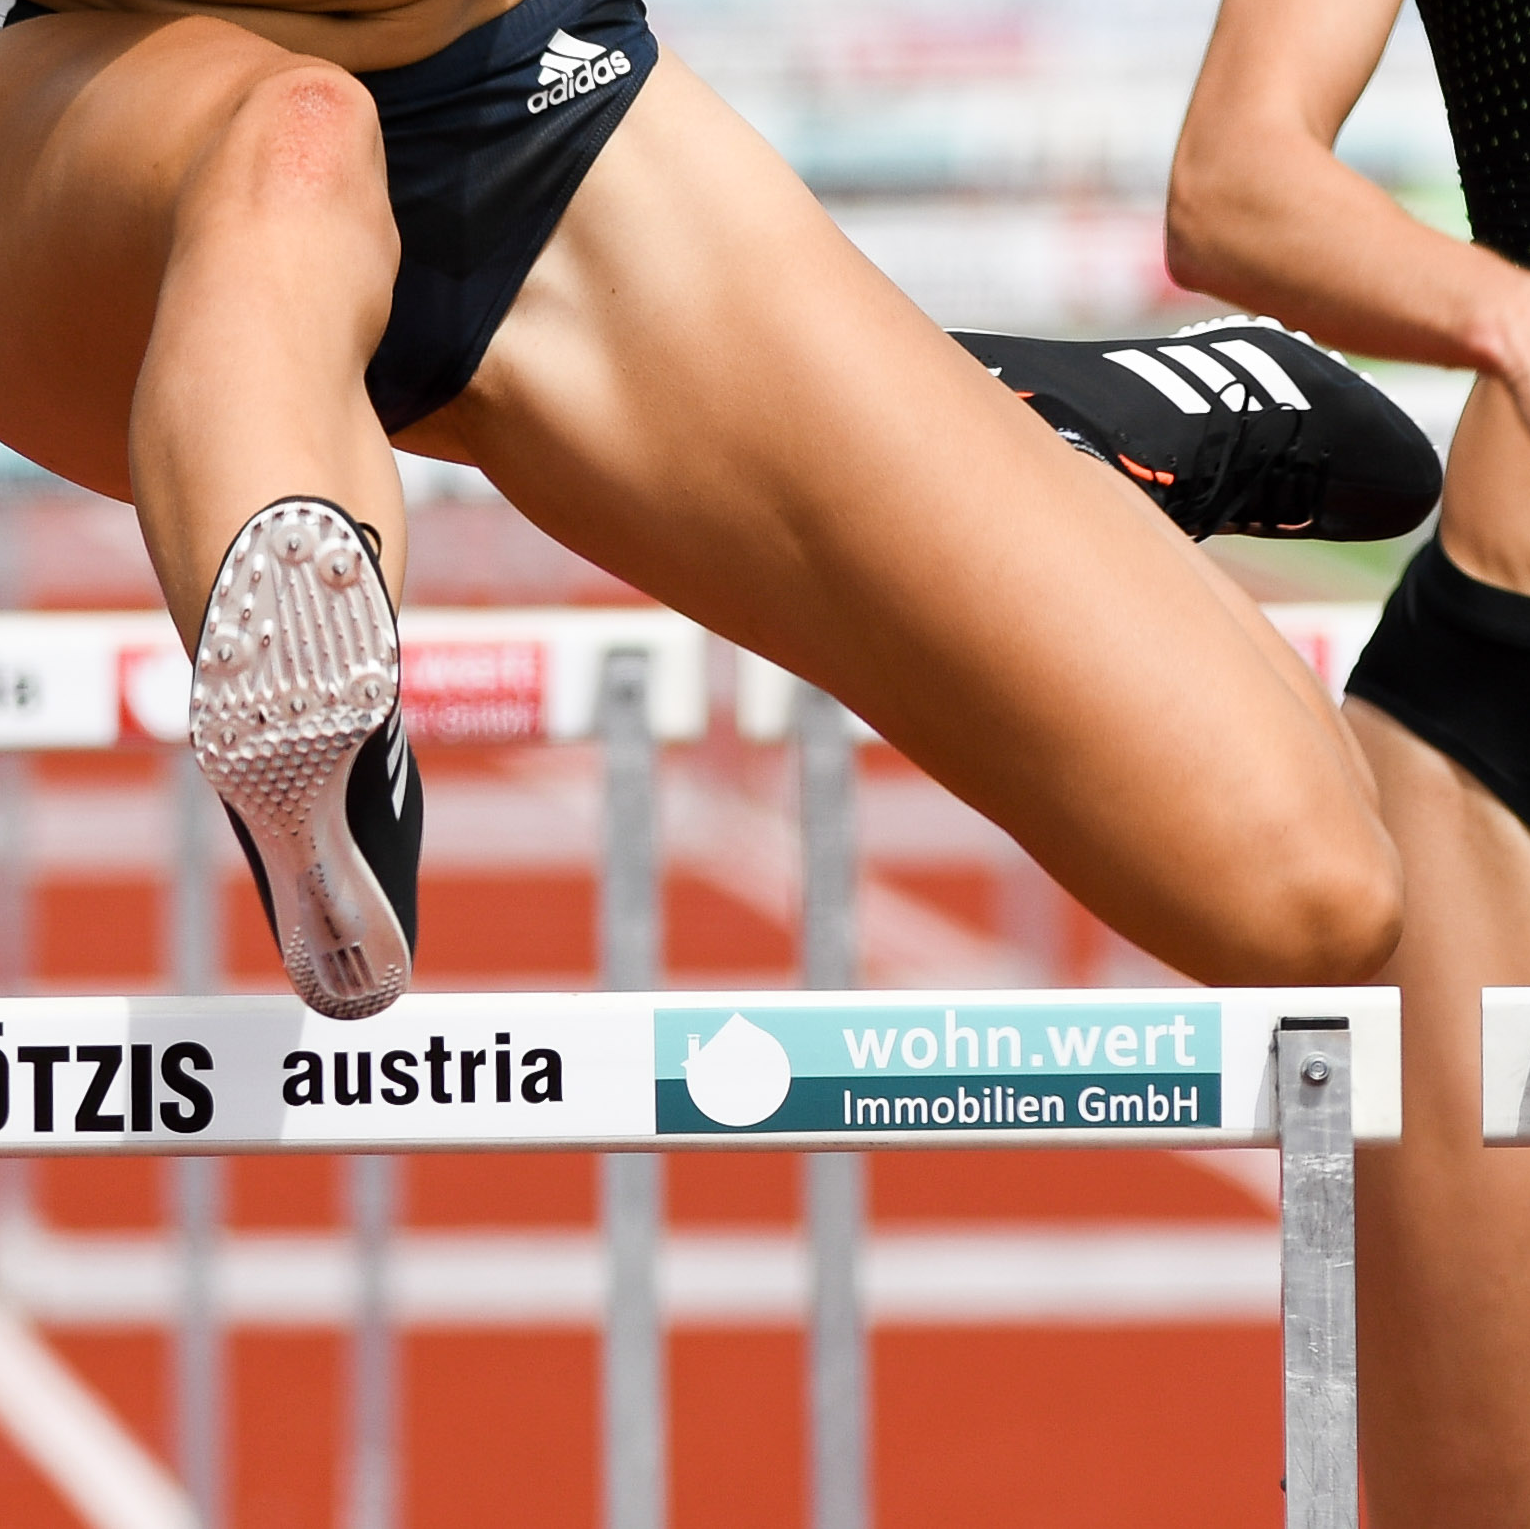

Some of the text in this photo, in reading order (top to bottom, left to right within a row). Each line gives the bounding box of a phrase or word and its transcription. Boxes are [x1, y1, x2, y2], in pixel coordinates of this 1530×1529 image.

[527, 48, 632, 116] adidas
[280, 1031, 563, 1107] austria
[843, 1011, 1196, 1070] wohn.wert
[843, 1085, 1199, 1126] Immobilien GmbH
